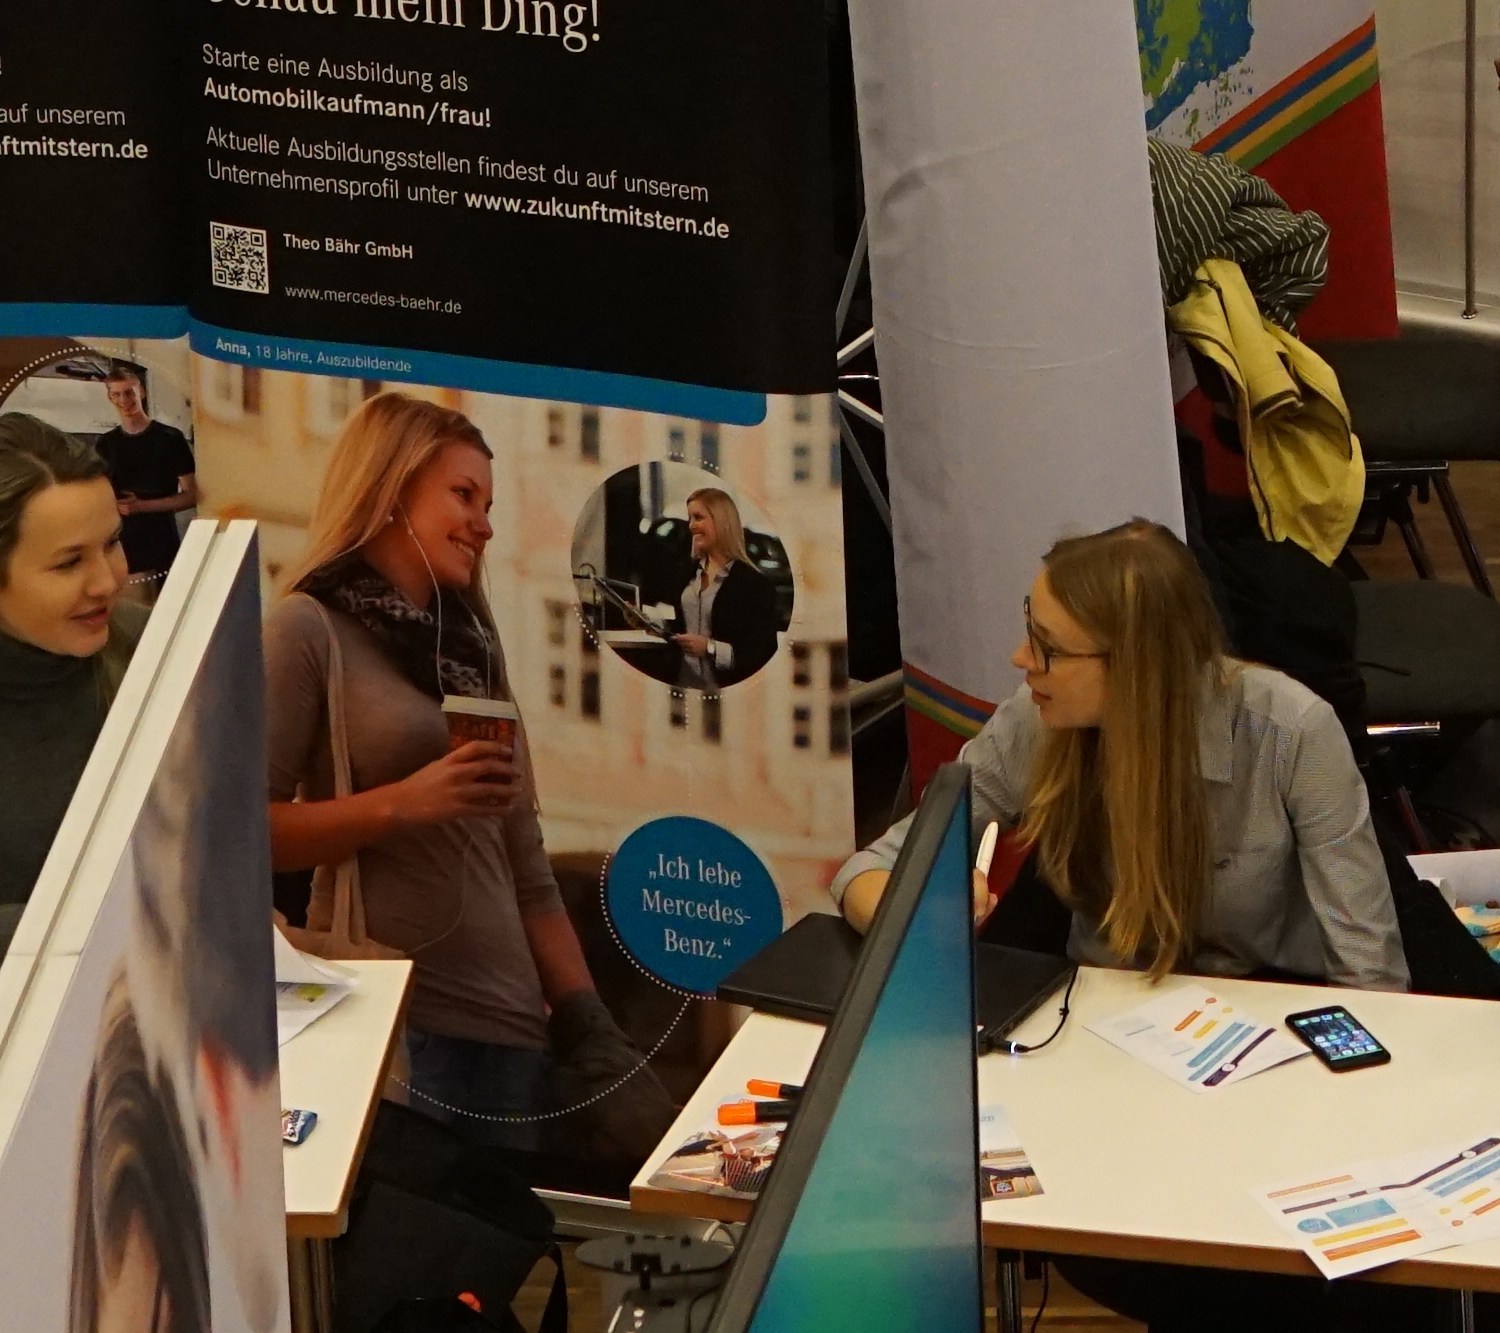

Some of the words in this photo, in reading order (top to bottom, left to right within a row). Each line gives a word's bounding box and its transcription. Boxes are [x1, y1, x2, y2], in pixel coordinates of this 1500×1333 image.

[204, 76, 491, 128] Automobilkaufmann/frau!
[699, 859, 742, 888] lebe
[642, 888, 751, 926] Mercedes-
